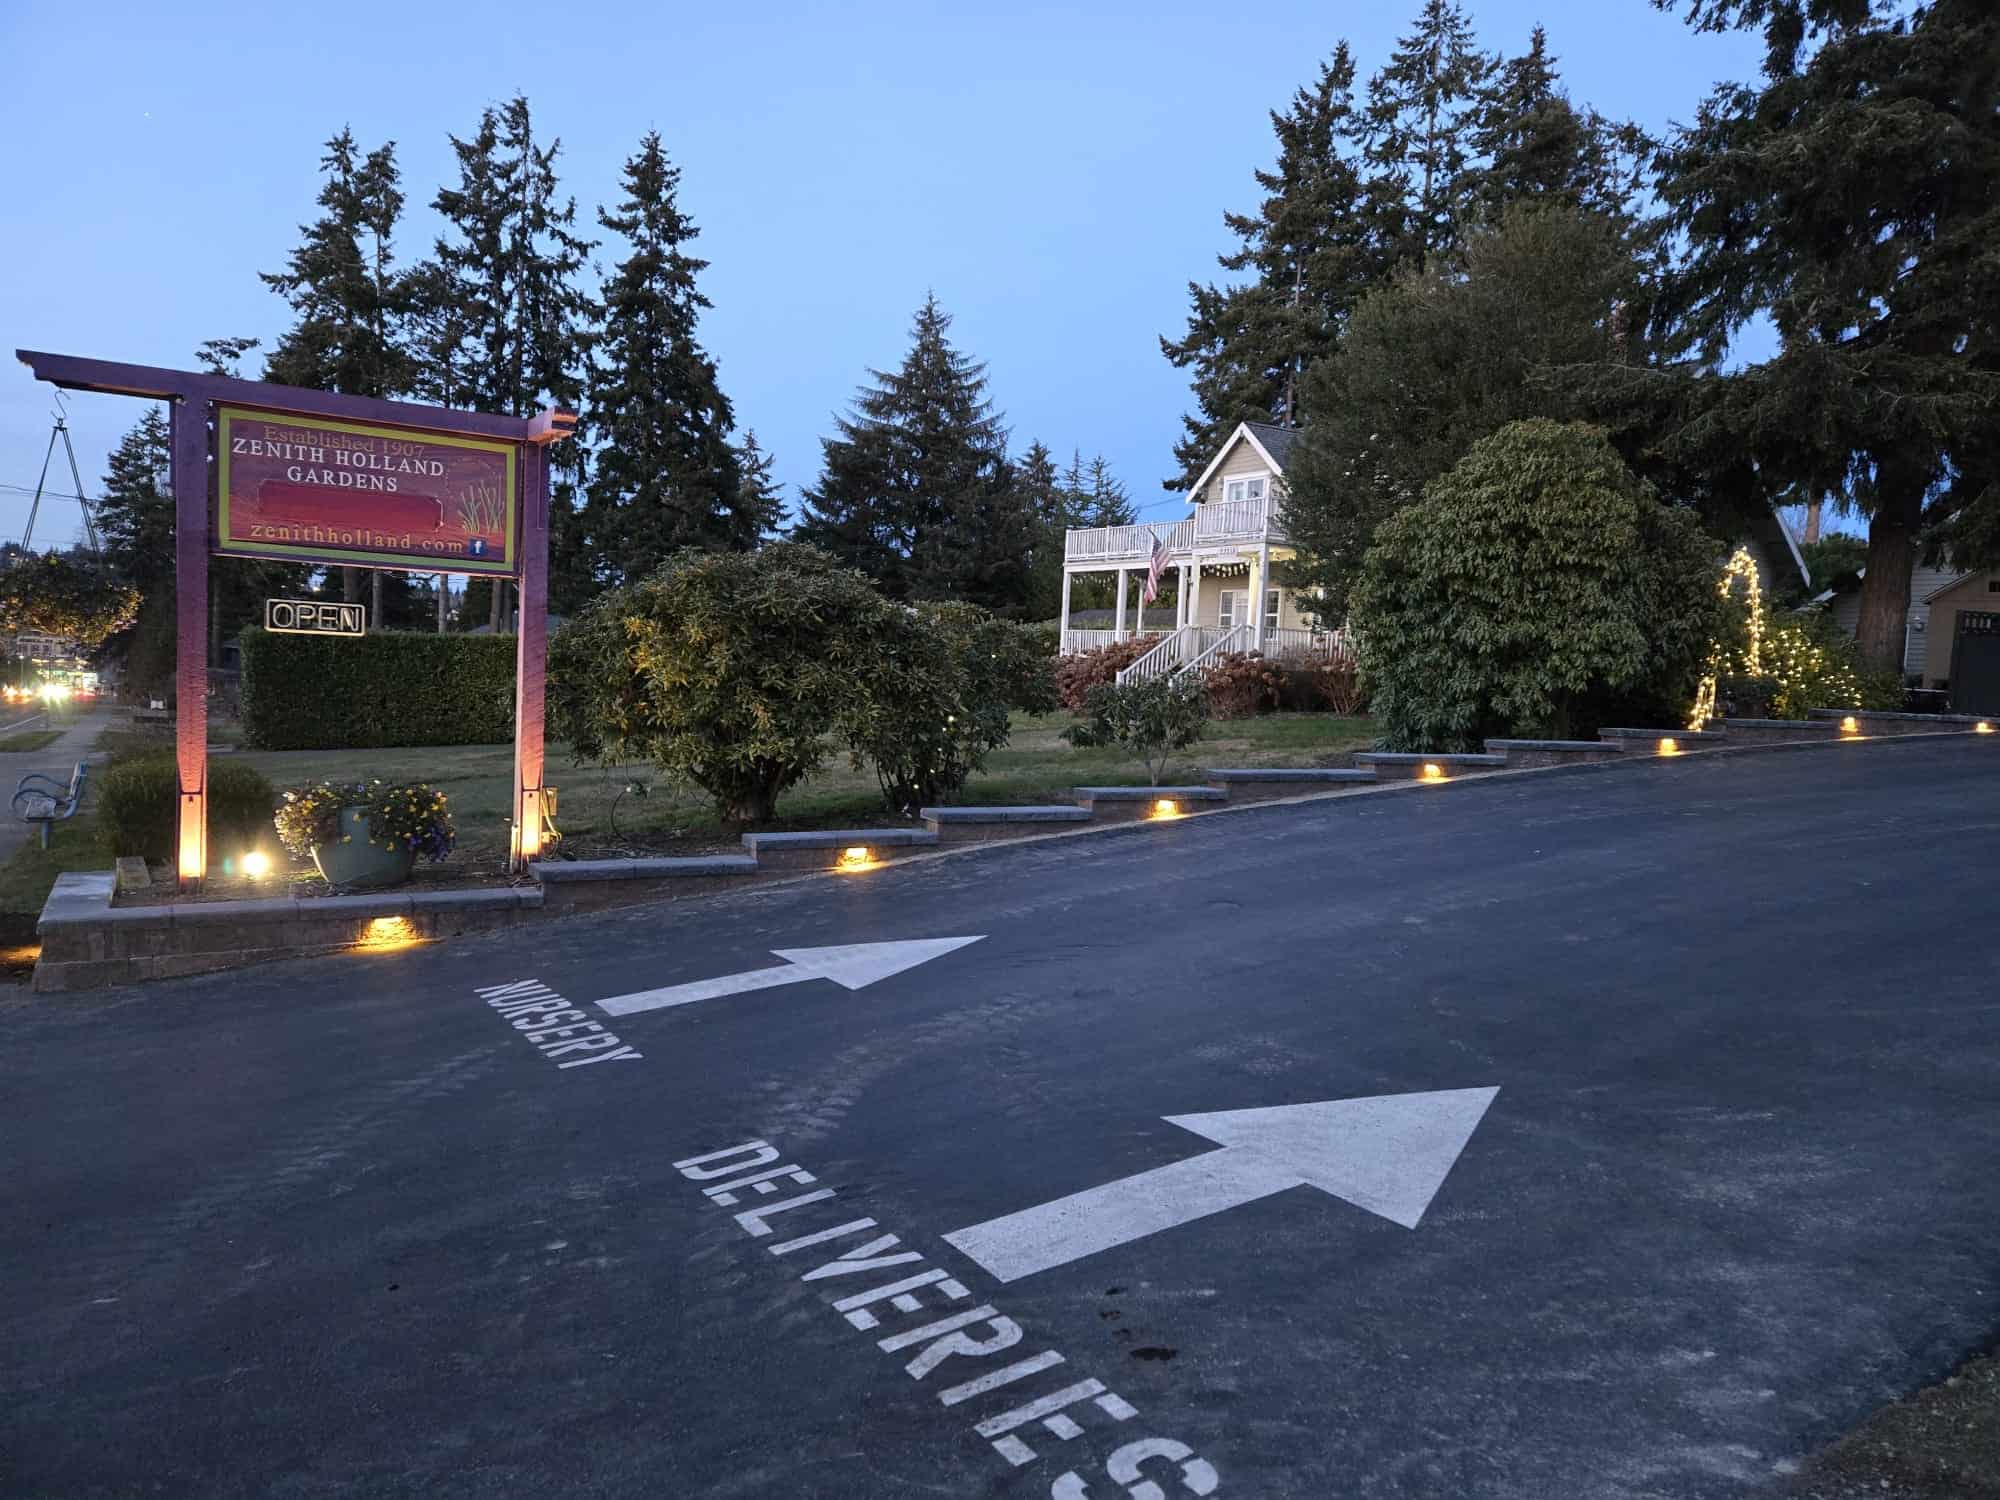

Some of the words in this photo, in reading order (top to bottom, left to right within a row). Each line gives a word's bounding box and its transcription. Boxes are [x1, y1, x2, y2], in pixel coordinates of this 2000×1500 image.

[232, 437, 324, 463] ZENITH
[336, 450, 444, 476] HOLLAND
[263, 425, 375, 452] Established
[383, 440, 424, 457] 1907
[287, 466, 398, 492] GARDENS
[250, 524, 463, 553] zenithholland.com
[272, 603, 360, 631] OPEN
[473, 978, 644, 1070] NURSERY
[672, 1139, 1219, 1500] DELIVERIES
